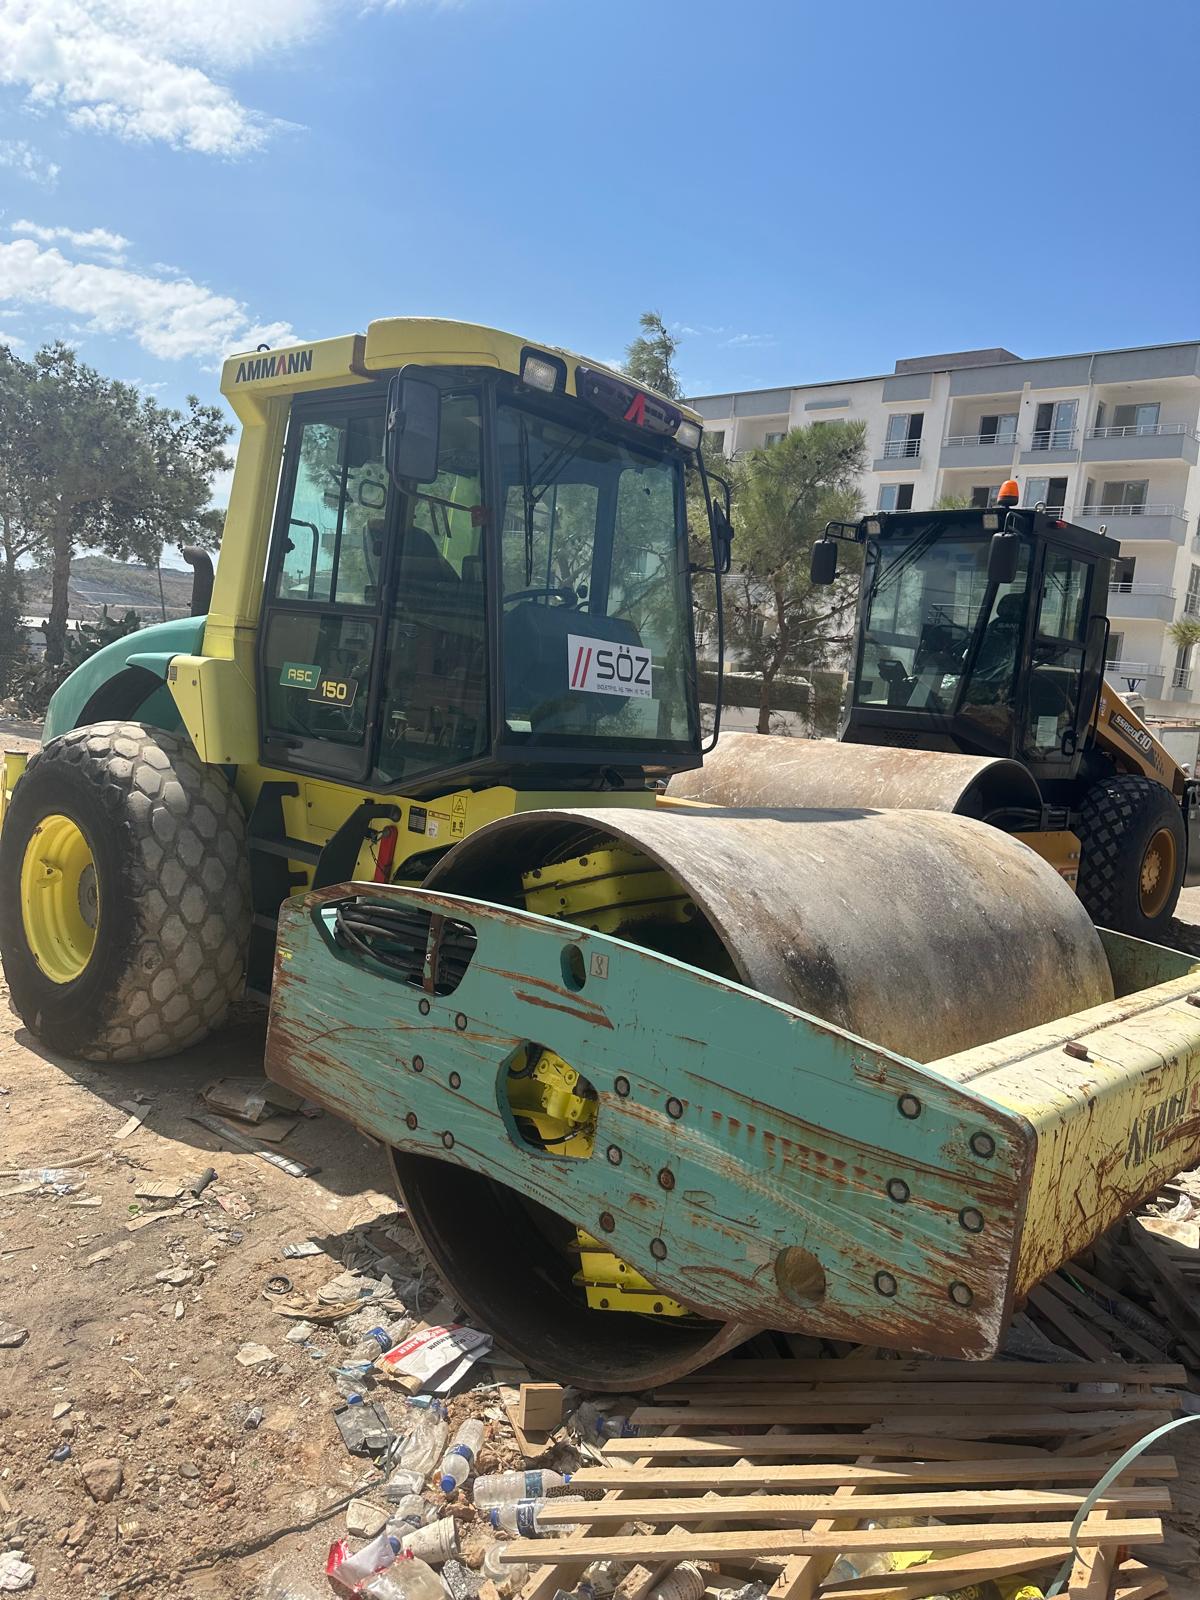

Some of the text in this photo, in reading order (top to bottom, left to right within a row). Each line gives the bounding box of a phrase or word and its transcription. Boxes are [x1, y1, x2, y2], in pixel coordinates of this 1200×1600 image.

[235, 350, 313, 383] AMMANN
[287, 668, 313, 683] ASC
[321, 680, 348, 700] 150
